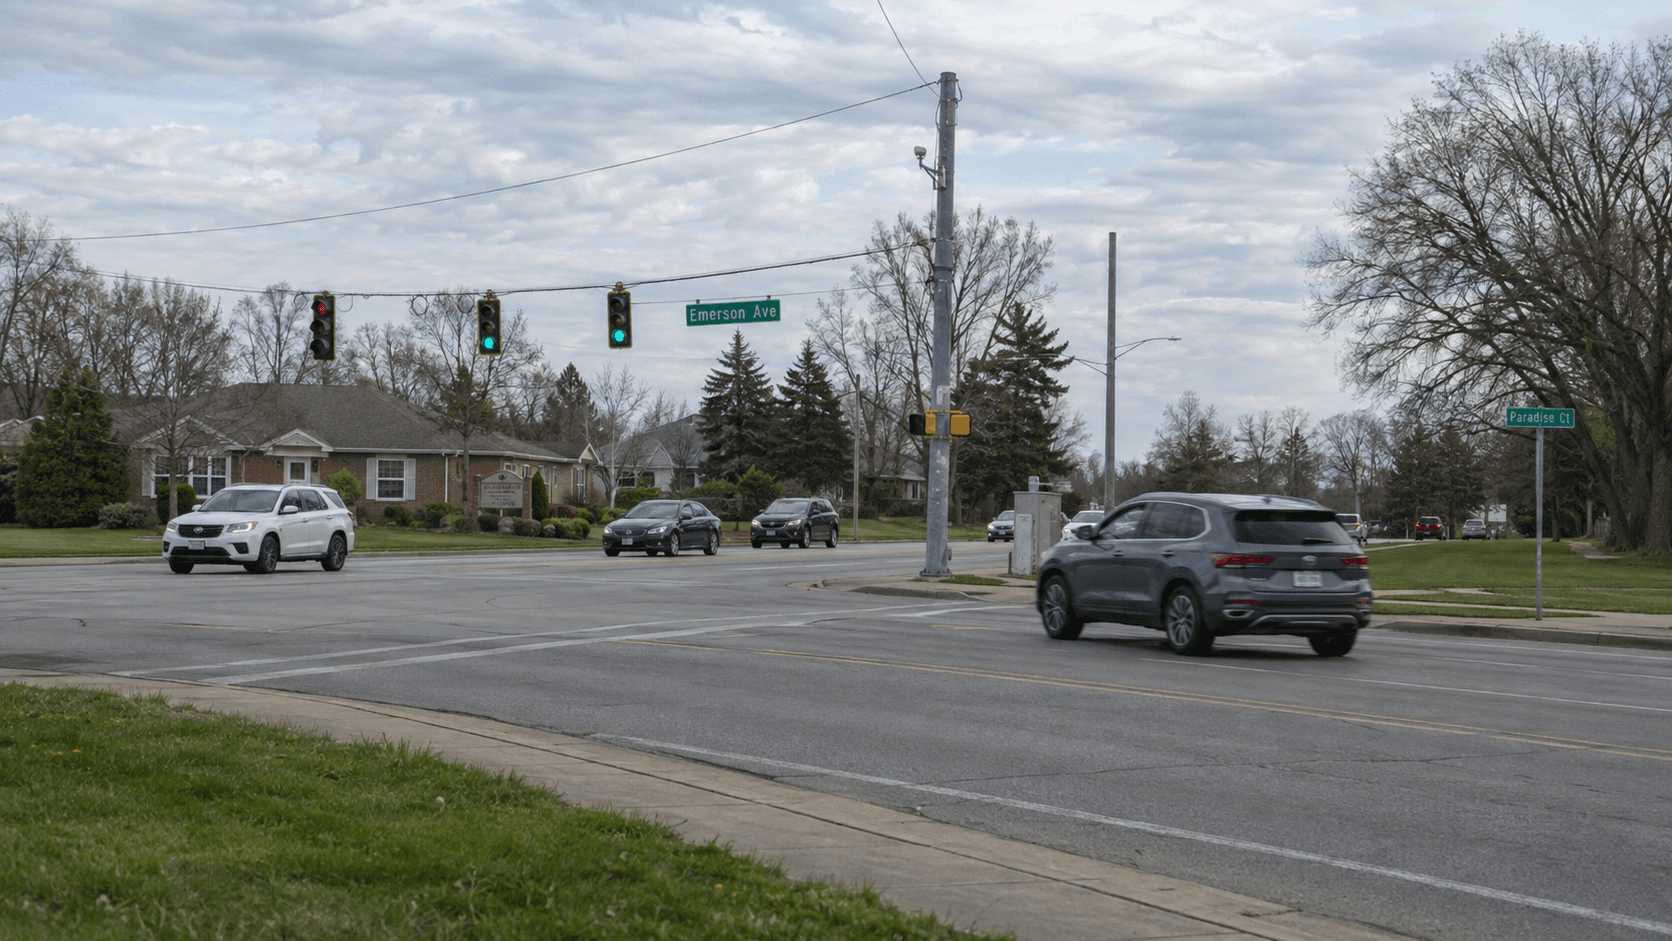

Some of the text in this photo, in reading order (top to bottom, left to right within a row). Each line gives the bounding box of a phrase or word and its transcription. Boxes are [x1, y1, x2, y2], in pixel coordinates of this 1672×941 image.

[690, 304, 776, 322] Emerson Ave
[1510, 411, 1570, 423] Paradise Ct
